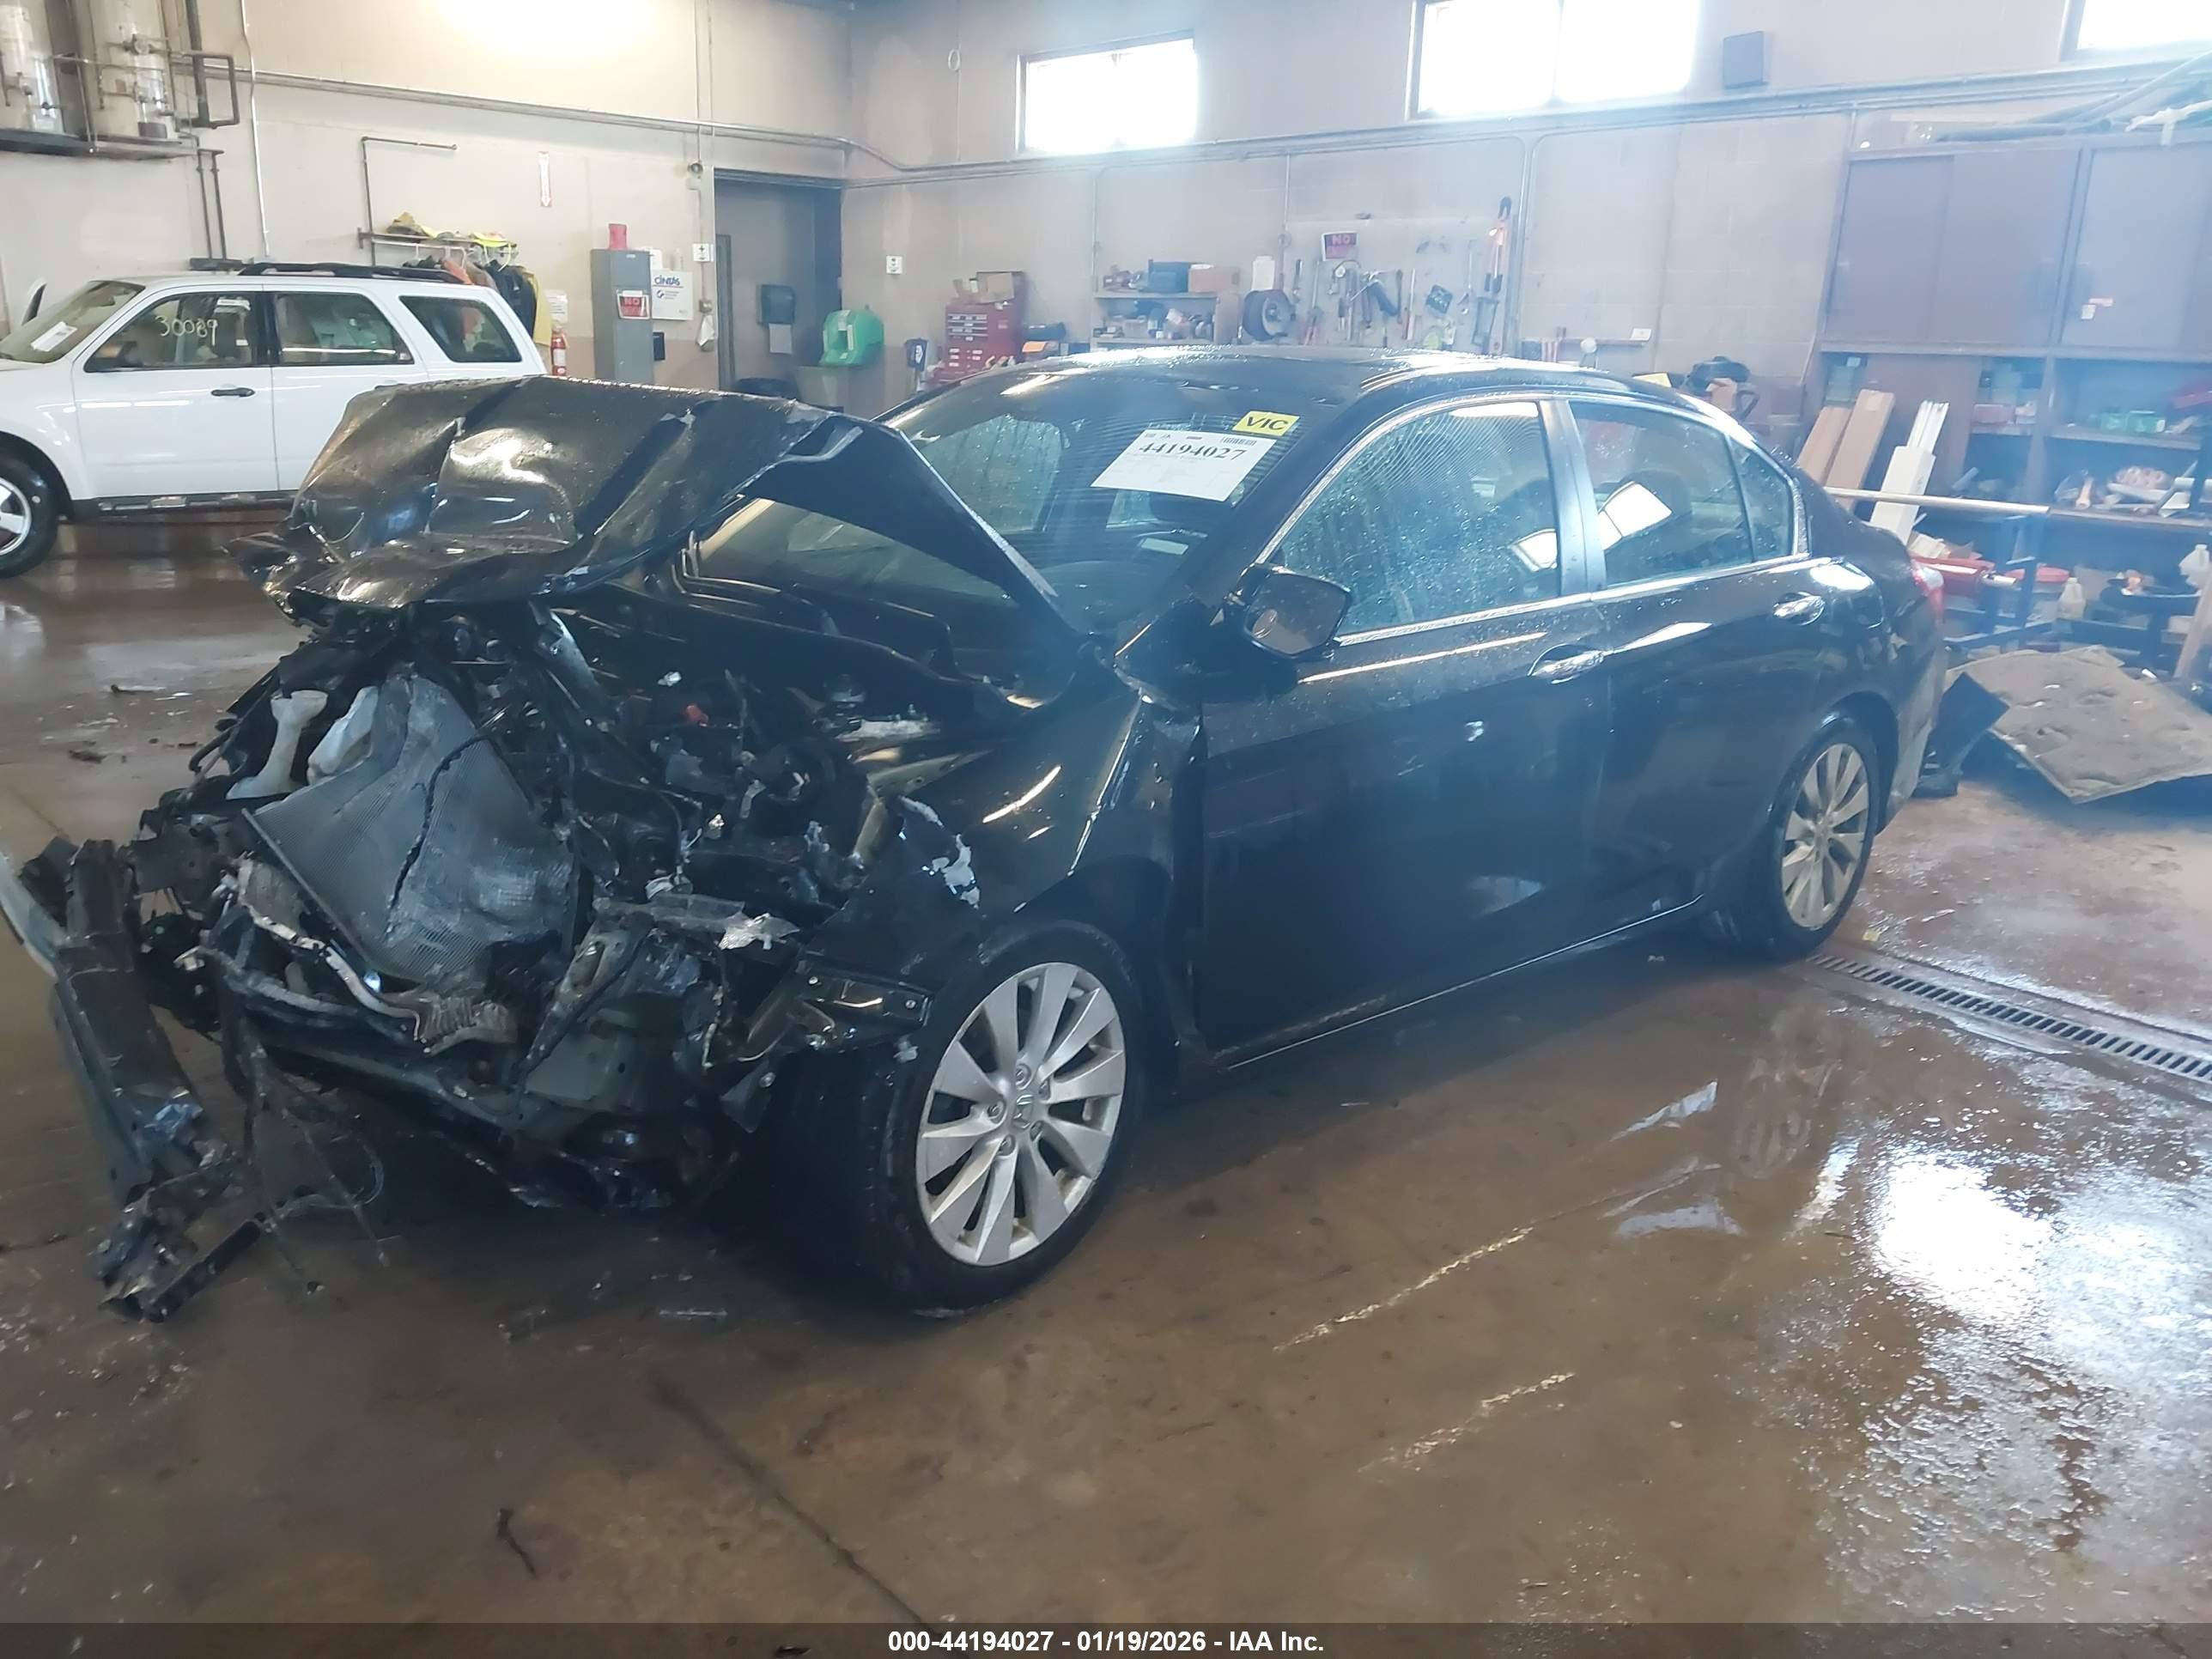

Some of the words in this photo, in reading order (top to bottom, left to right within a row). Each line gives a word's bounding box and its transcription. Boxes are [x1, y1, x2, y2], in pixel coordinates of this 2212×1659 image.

[155, 315, 219, 347] 30089
[1246, 416, 1291, 431] VIC
[1138, 441, 1248, 461] 44194027
